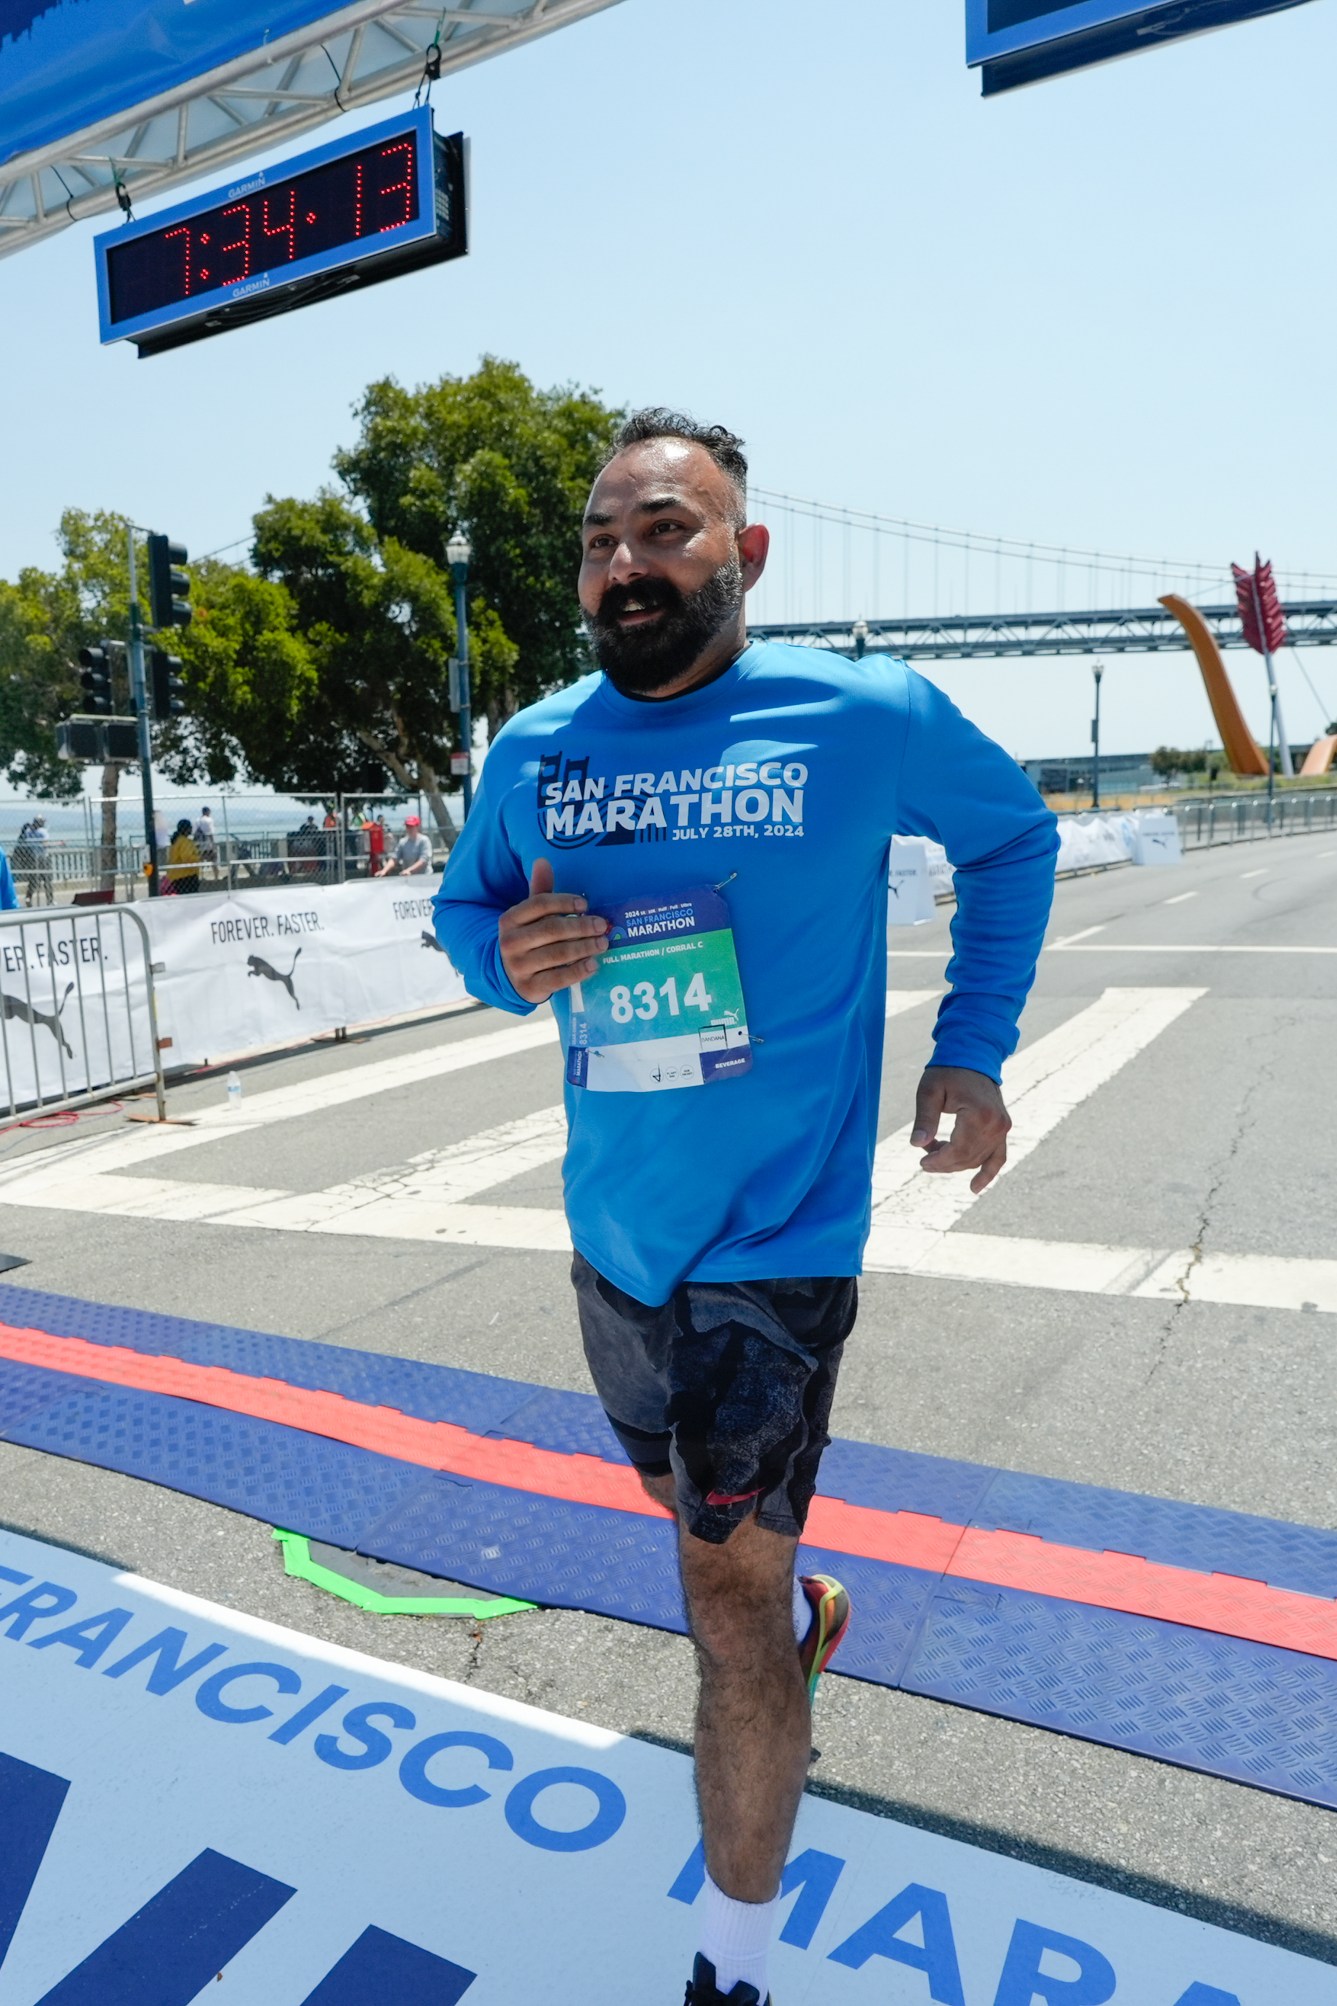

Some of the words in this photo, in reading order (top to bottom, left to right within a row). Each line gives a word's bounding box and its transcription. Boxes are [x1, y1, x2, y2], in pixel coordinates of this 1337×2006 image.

[228, 176, 266, 199] GARMIN
[232, 277, 270, 297] GARMIN
[545, 777, 605, 805] SAN
[614, 762, 808, 797] FRANCISCO
[546, 788, 805, 840] MARATHON
[672, 828, 709, 841] JULY
[713, 825, 760, 839] 28TH,
[764, 824, 805, 838] 2024
[624, 910, 640, 918] 2024
[626, 918, 643, 927] SAN
[644, 908, 694, 925] FRANCISCO
[210, 916, 274, 944] FOREVER.
[276, 911, 324, 935] FASTER.
[627, 916, 695, 938] MARATHON
[603, 955, 620, 965] FULL
[620, 948, 660, 961] MARATHON
[666, 942, 697, 953] CORRAL
[609, 972, 712, 1024] 8314
[715, 1058, 745, 1069] BEVERAGE
